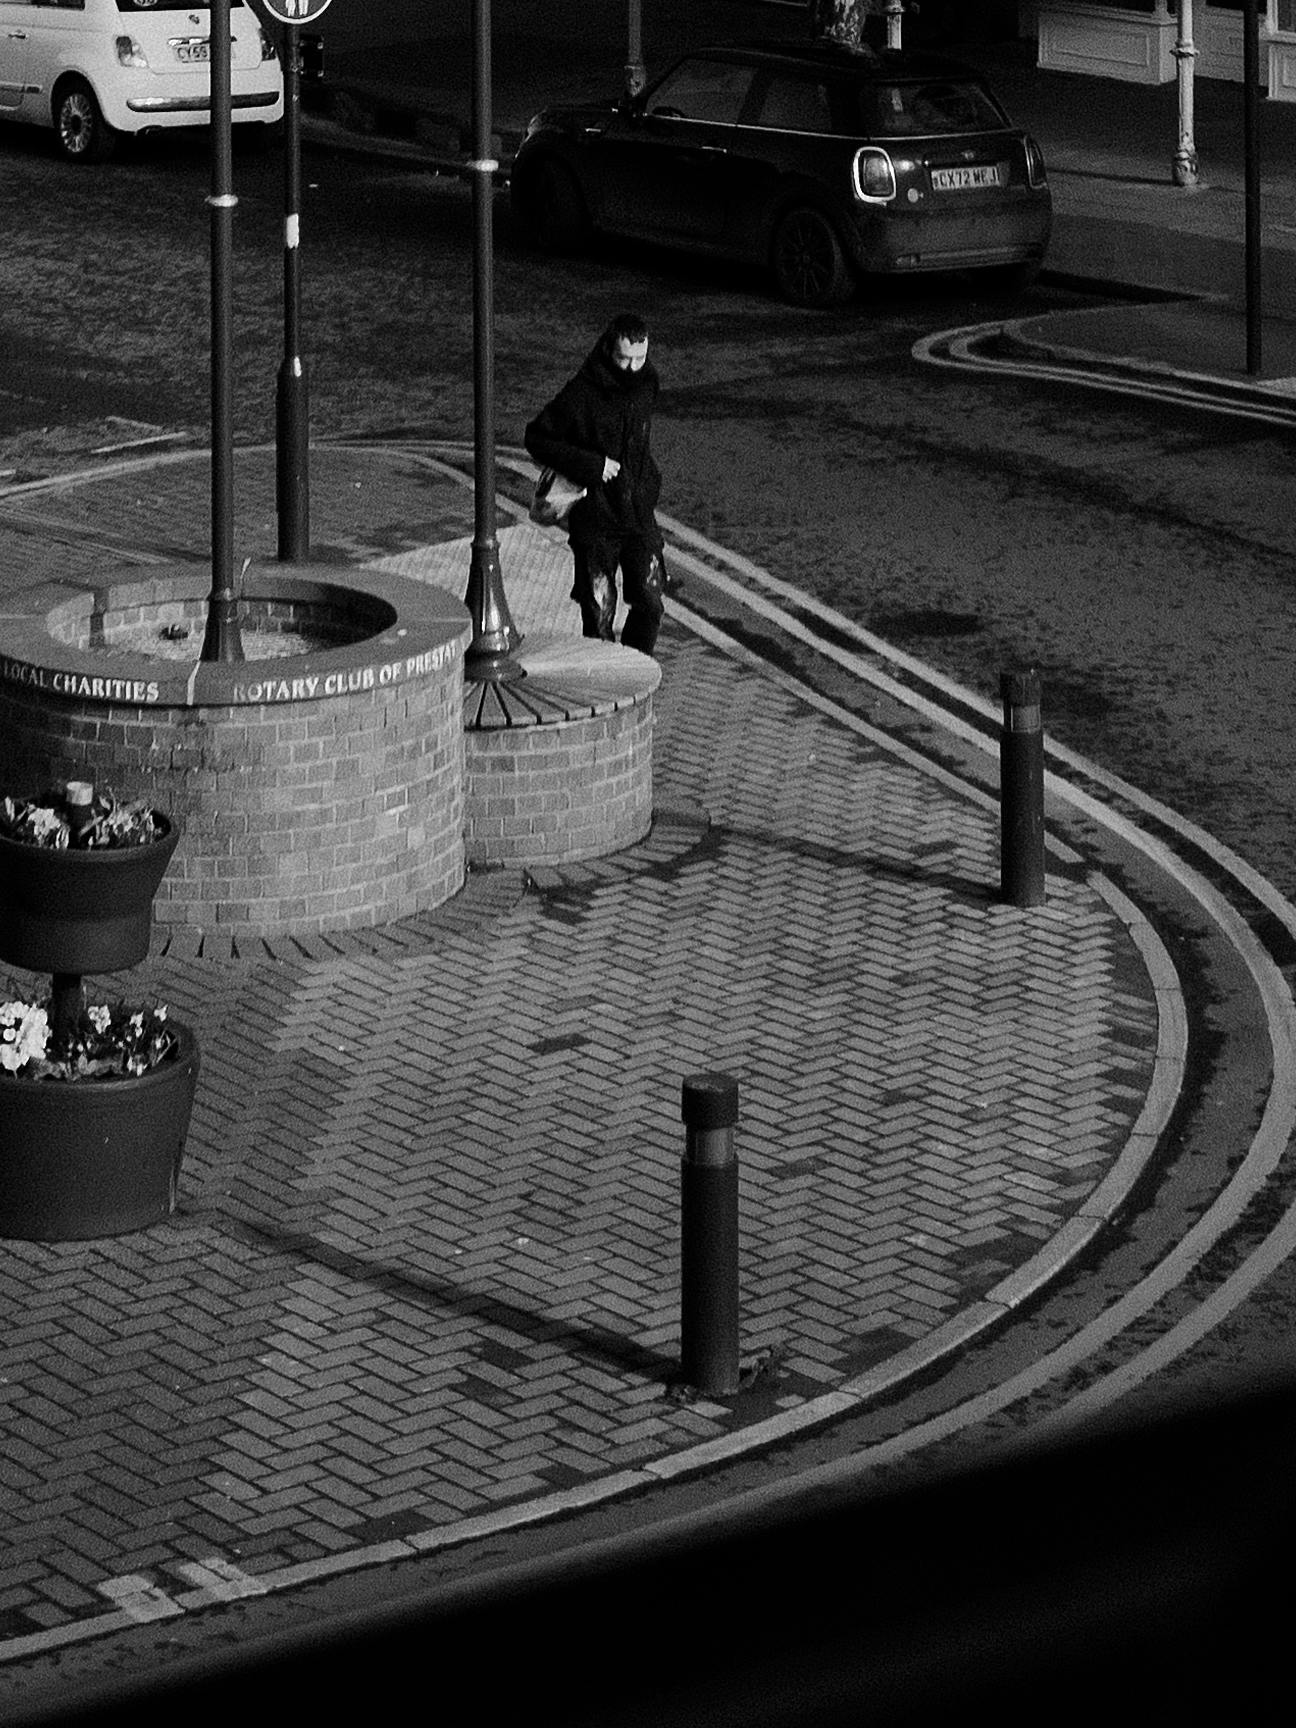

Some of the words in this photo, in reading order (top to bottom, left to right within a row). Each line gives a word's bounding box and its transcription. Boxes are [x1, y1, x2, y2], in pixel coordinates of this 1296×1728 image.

[4, 657, 49, 689] LOCAL
[52, 673, 160, 702] CHARITIES
[233, 675, 320, 703] ROTARY
[324, 666, 376, 696] CLUB
[379, 661, 402, 686] OF
